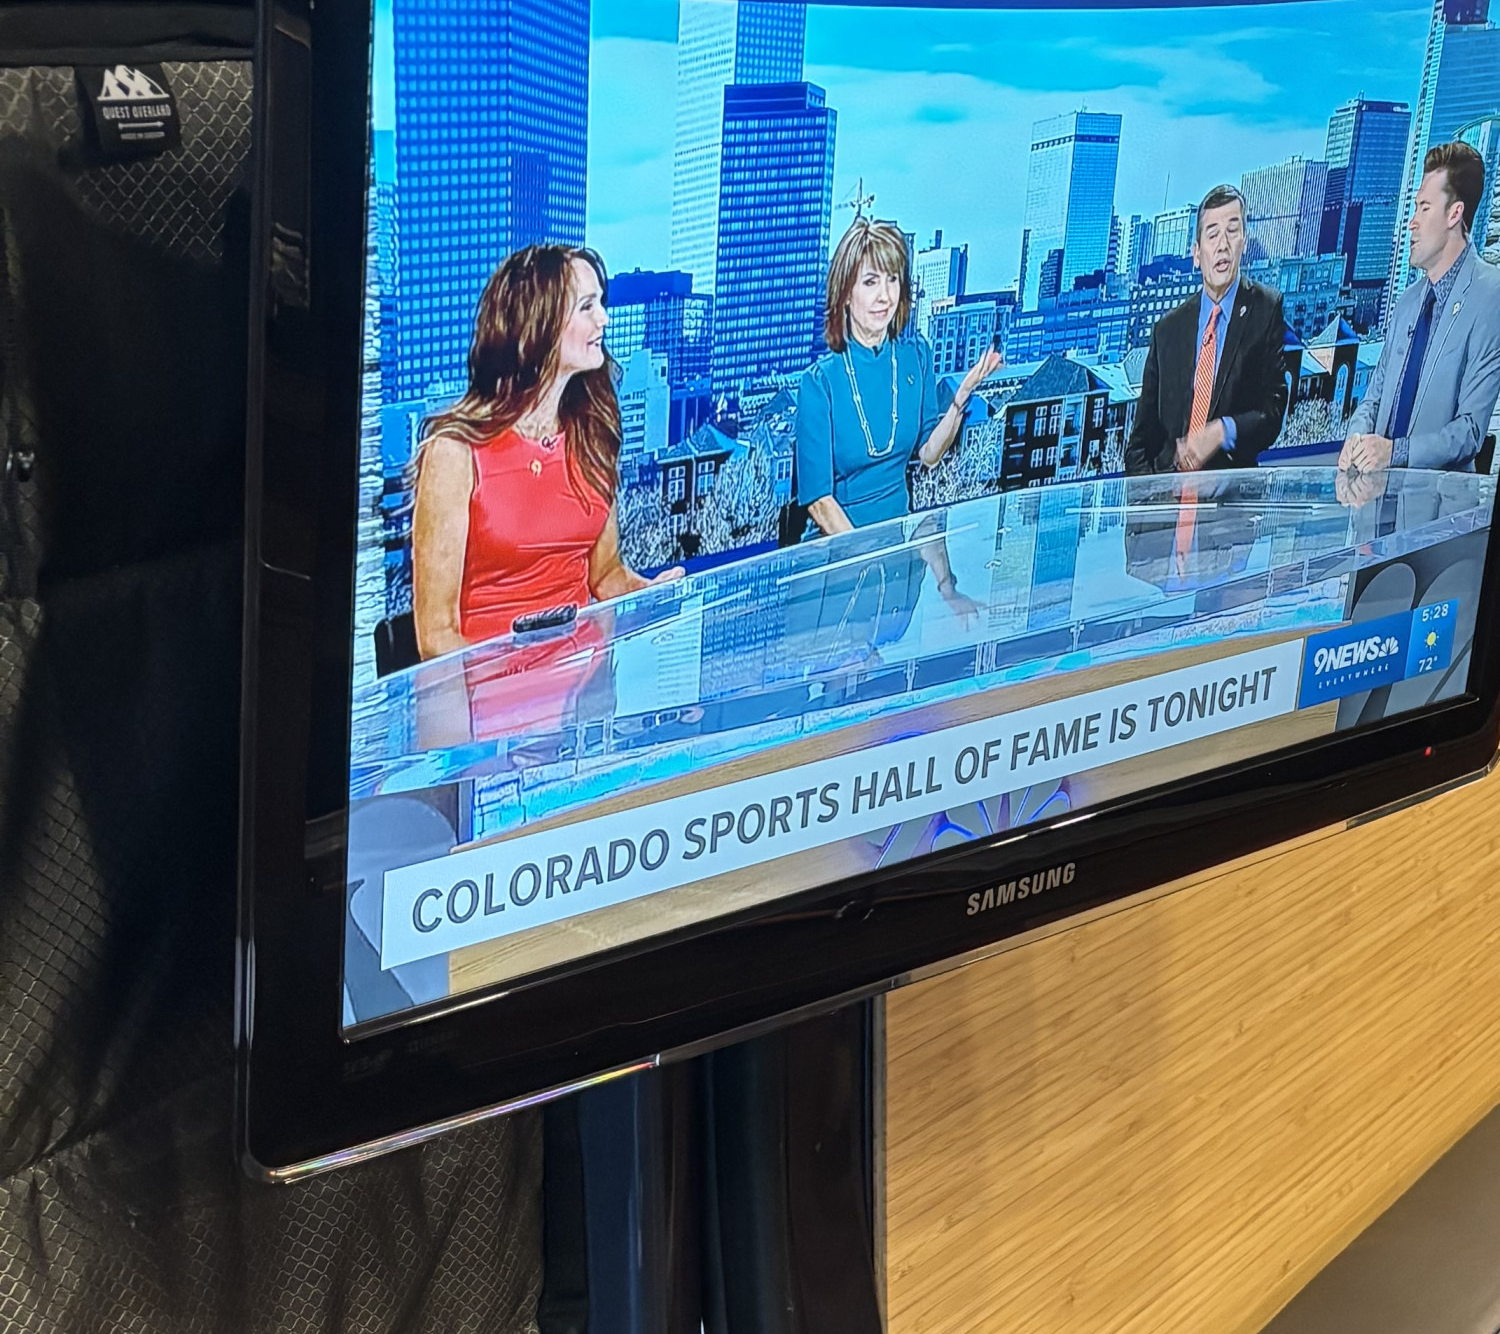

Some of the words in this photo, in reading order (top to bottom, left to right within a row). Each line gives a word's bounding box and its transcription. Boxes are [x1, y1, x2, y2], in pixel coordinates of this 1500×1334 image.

[103, 106, 130, 119] QUEST
[133, 105, 171, 117] OVERLAND
[1421, 603, 1449, 622] 5:28
[1313, 635, 1382, 676] 9NEWS
[1318, 662, 1389, 689] EVERYWHERE
[411, 827, 671, 934] COLORADO
[682, 781, 840, 860] SPORTS
[851, 755, 941, 816] HALL
[954, 736, 1002, 785] OF
[1009, 712, 1102, 771] FAME
[1109, 703, 1138, 746] IS
[1146, 666, 1278, 734] TONIGHT
[965, 862, 1077, 917] SAMSUNG
